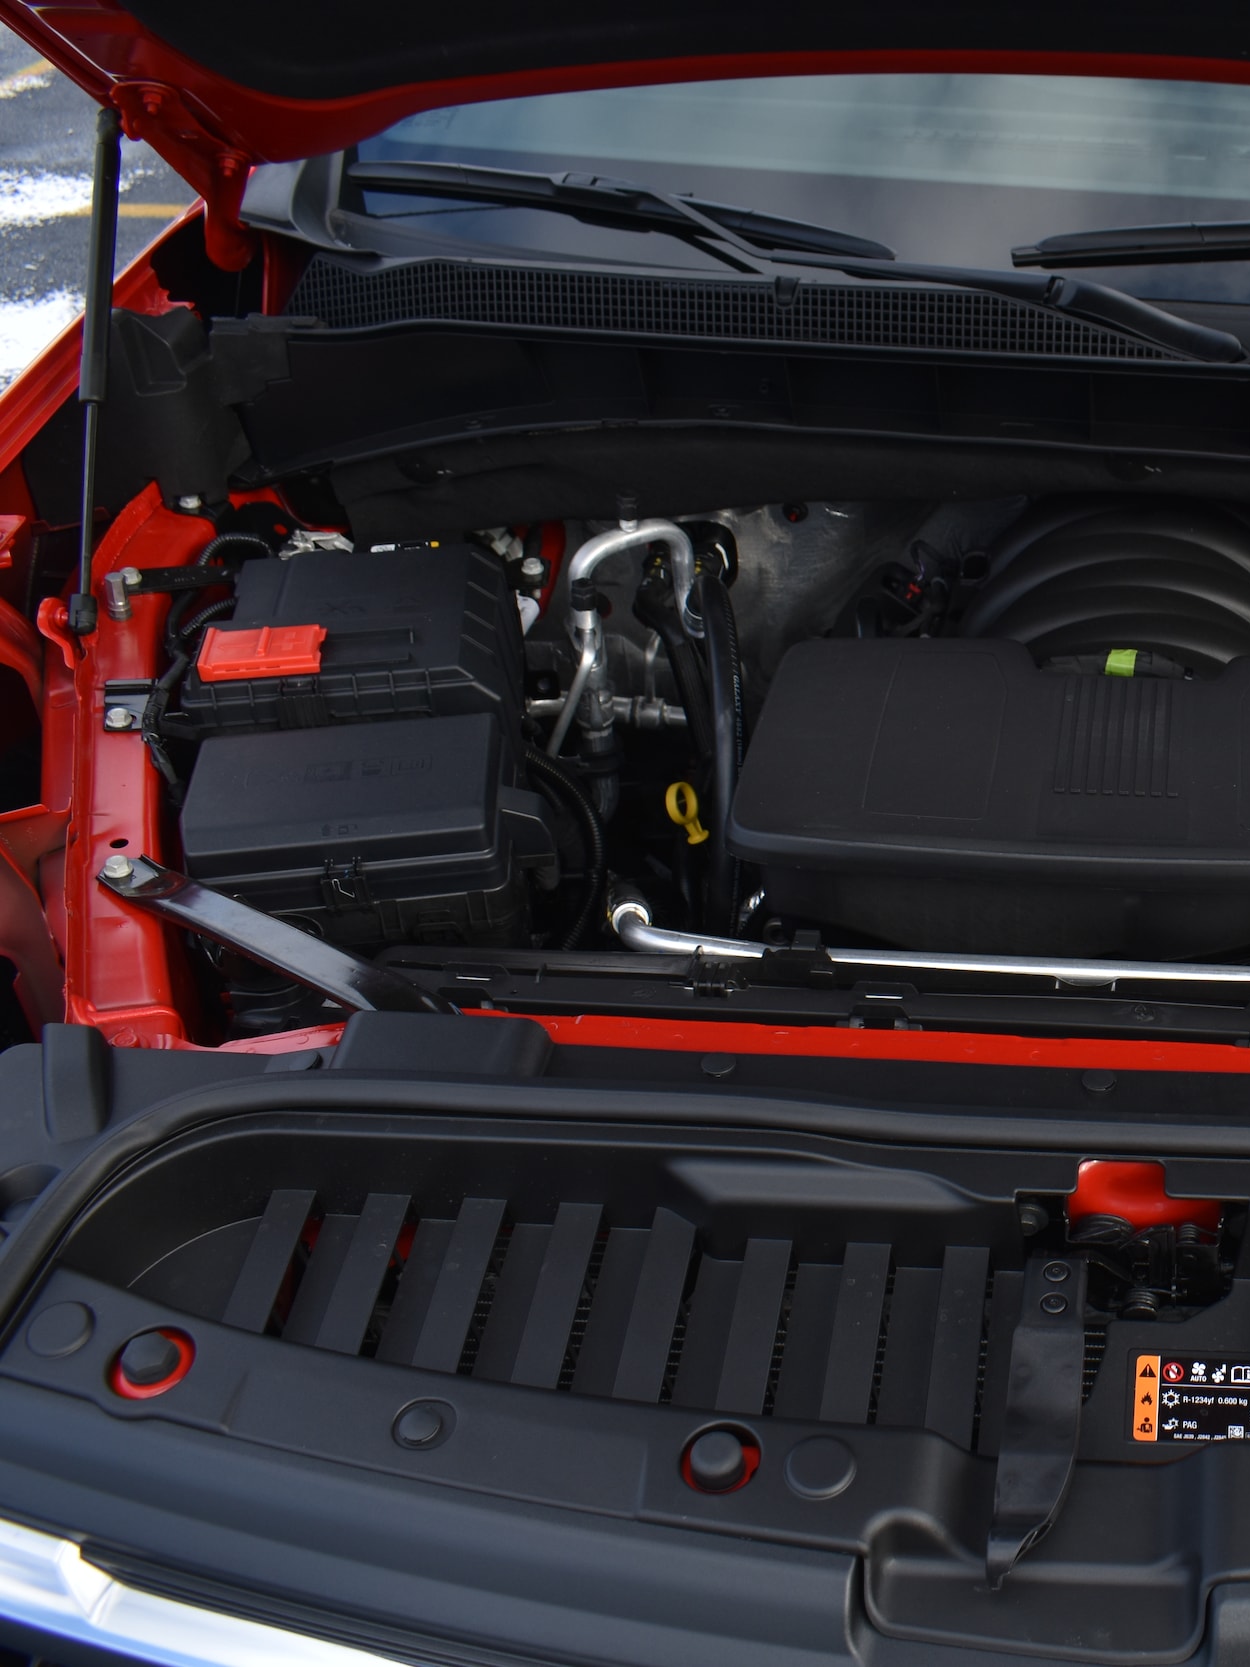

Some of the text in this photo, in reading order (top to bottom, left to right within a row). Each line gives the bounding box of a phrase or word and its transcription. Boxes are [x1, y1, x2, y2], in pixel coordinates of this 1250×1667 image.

[1183, 1396, 1248, 1406] R-1234yf 0.600 kg
[1182, 1421, 1197, 1429] PAG
